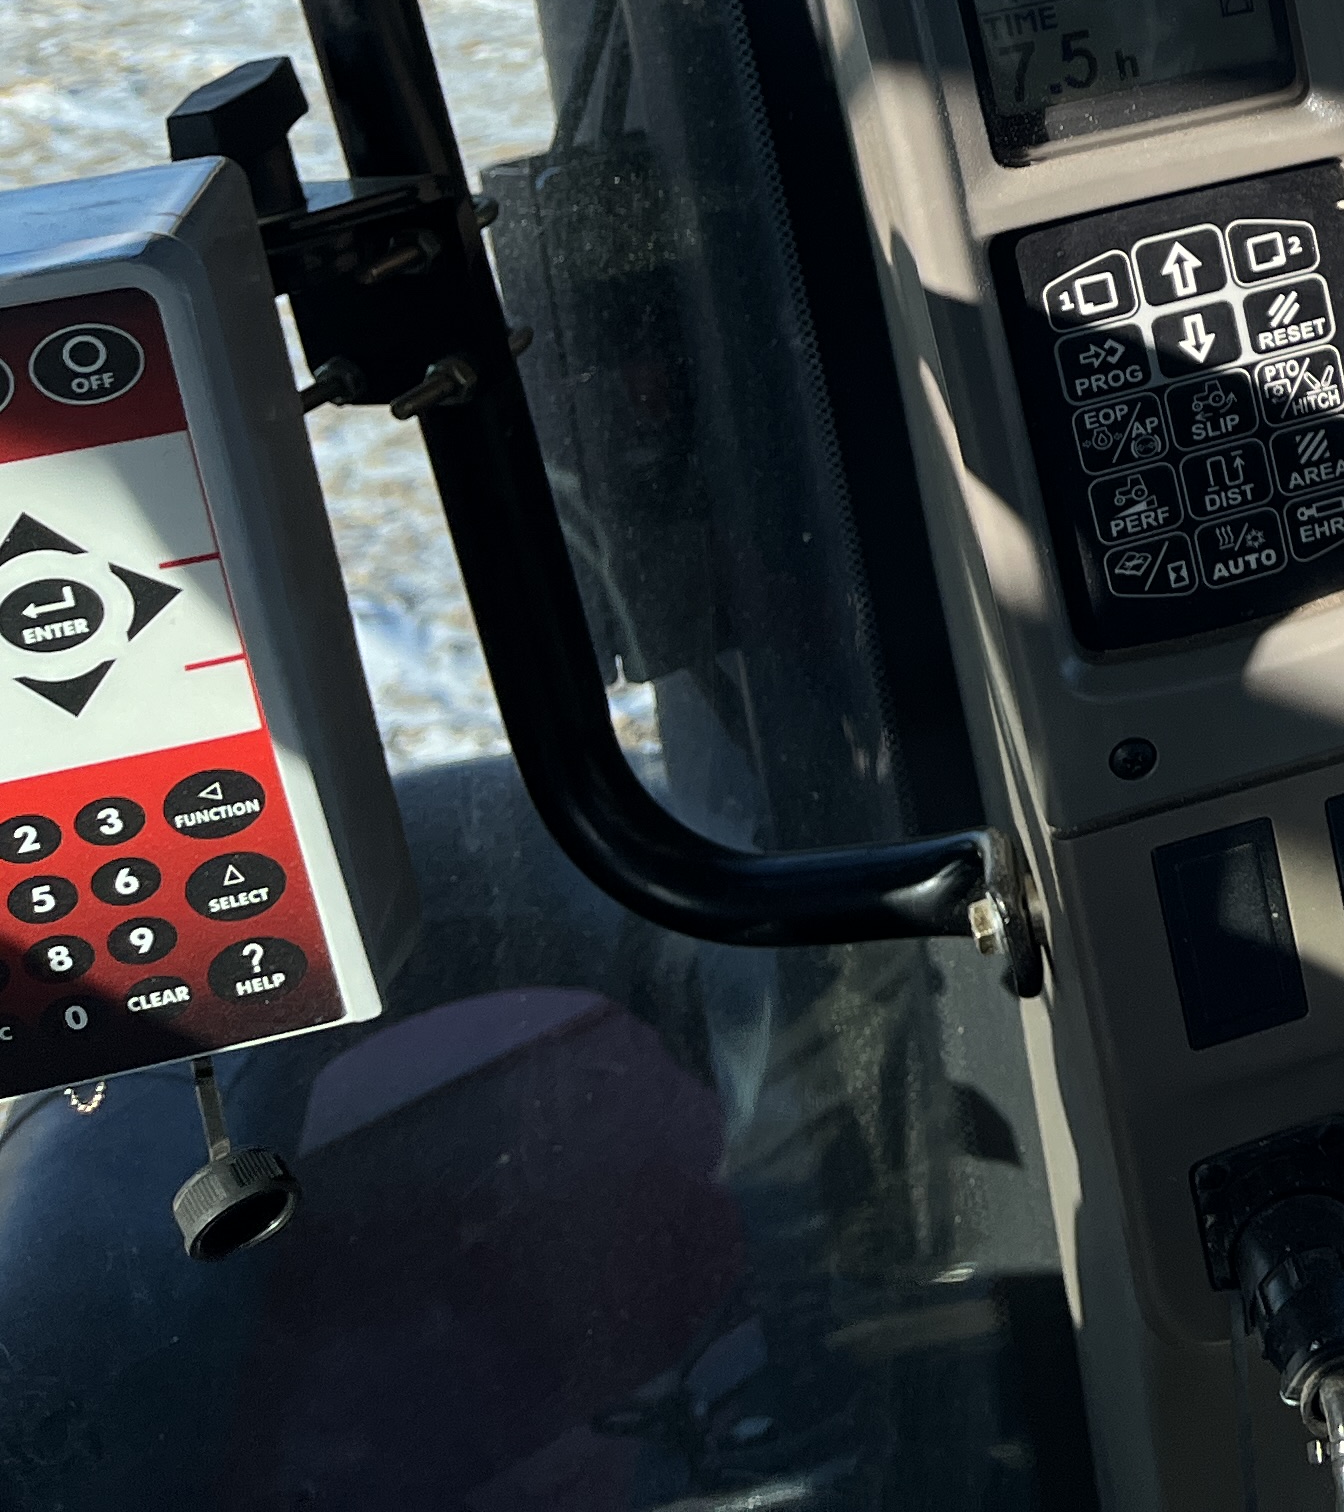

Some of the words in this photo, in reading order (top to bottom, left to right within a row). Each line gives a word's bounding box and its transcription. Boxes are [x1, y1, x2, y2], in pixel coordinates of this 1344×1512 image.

[984, 5, 1059, 41] TIME
[1000, 30, 1098, 102] 7.5
[1114, 48, 1140, 81] h
[1287, 236, 1303, 255] 2
[1058, 291, 1075, 312] 1
[1259, 318, 1326, 350] RESET
[71, 372, 115, 394] OFF
[1075, 365, 1143, 396] PROG
[1264, 360, 1299, 380] PTO
[1084, 404, 1129, 429] EOP
[1292, 391, 1341, 417] HITCH
[1131, 417, 1160, 438] AP
[1191, 414, 1239, 441] SLIP
[1205, 485, 1256, 512] DIST
[1110, 508, 1170, 537] PERF
[1213, 549, 1277, 580] AUTO
[22, 617, 90, 645] ENTER
[95, 807, 124, 836] 3
[174, 798, 260, 830] FUNCTION
[13, 824, 42, 855] 2
[114, 867, 140, 895] 6
[30, 885, 57, 914] 5
[208, 887, 270, 914] SELECT
[129, 926, 155, 955] 9
[47, 945, 74, 972] 8
[234, 972, 286, 997] HELP
[127, 985, 191, 1014] CLEAR
[64, 1005, 89, 1031] 0
